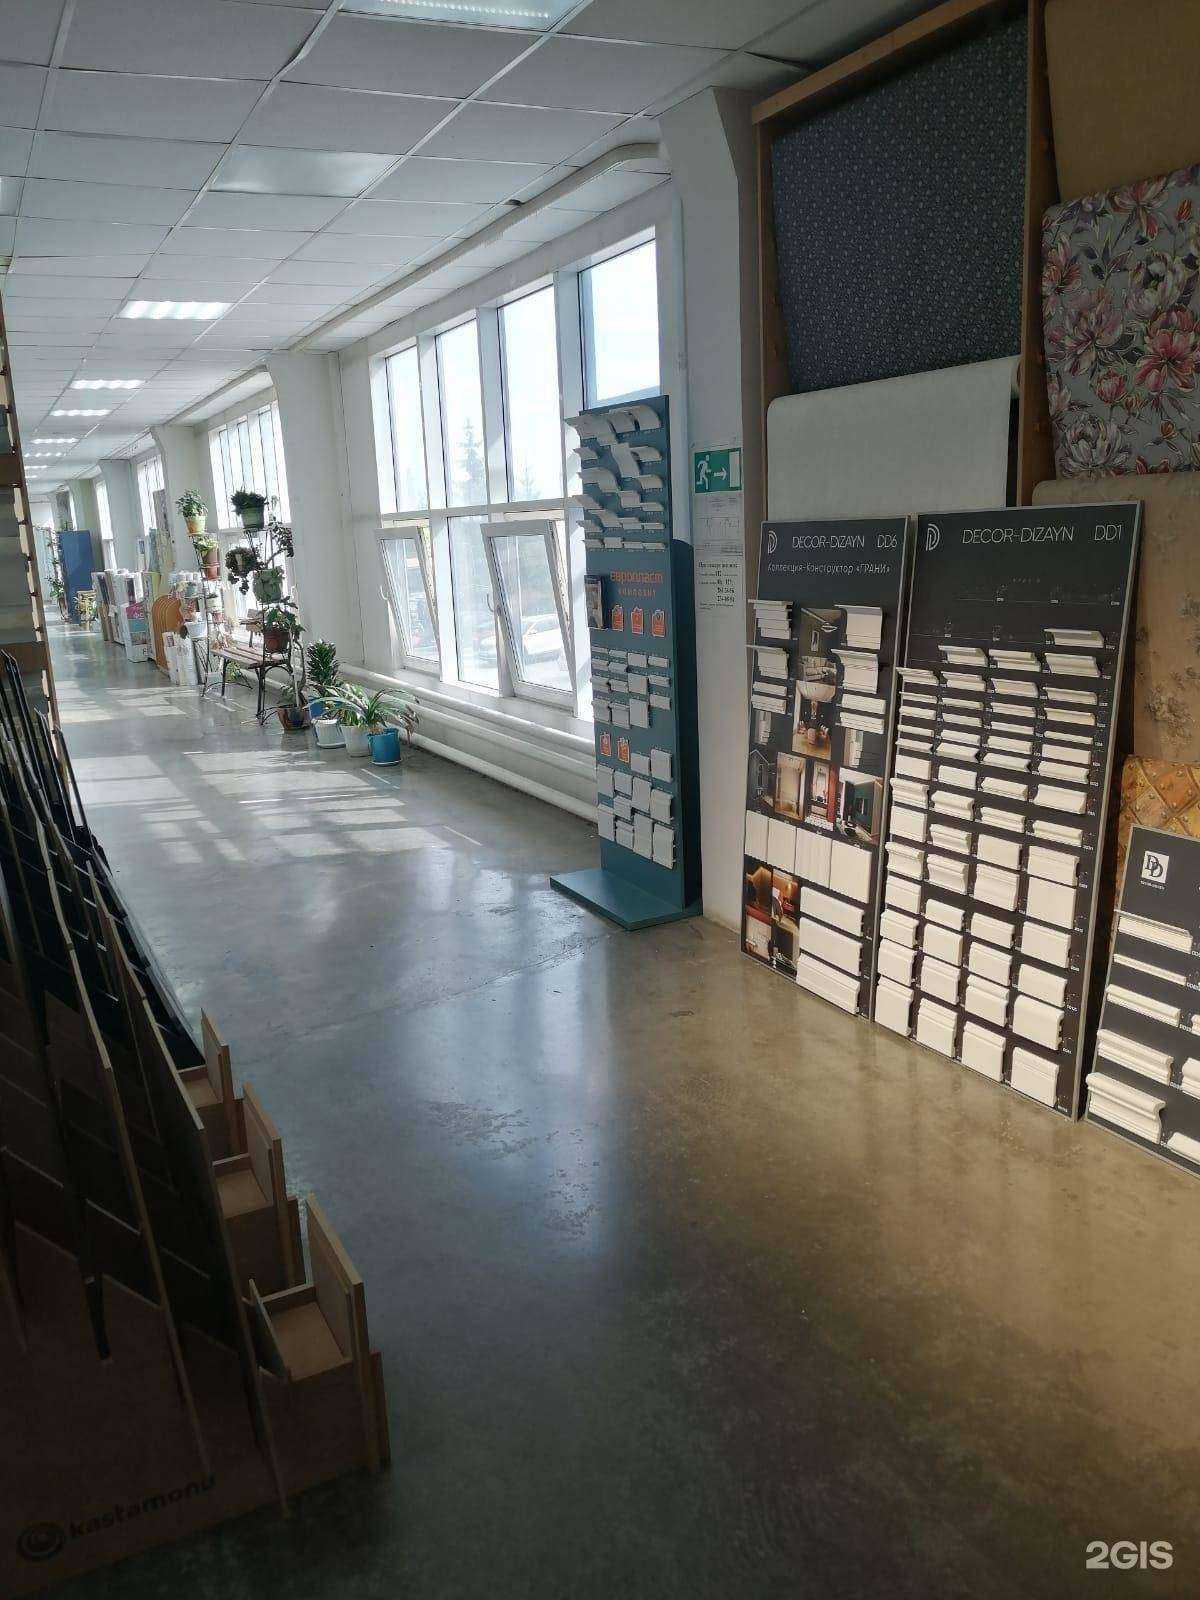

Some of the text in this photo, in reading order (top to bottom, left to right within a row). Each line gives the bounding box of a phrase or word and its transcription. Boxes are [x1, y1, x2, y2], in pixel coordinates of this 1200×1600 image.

[792, 535, 865, 549] DECOR-DIZAYN
[962, 524, 1122, 544] DECOR-DIZAYN DD1
